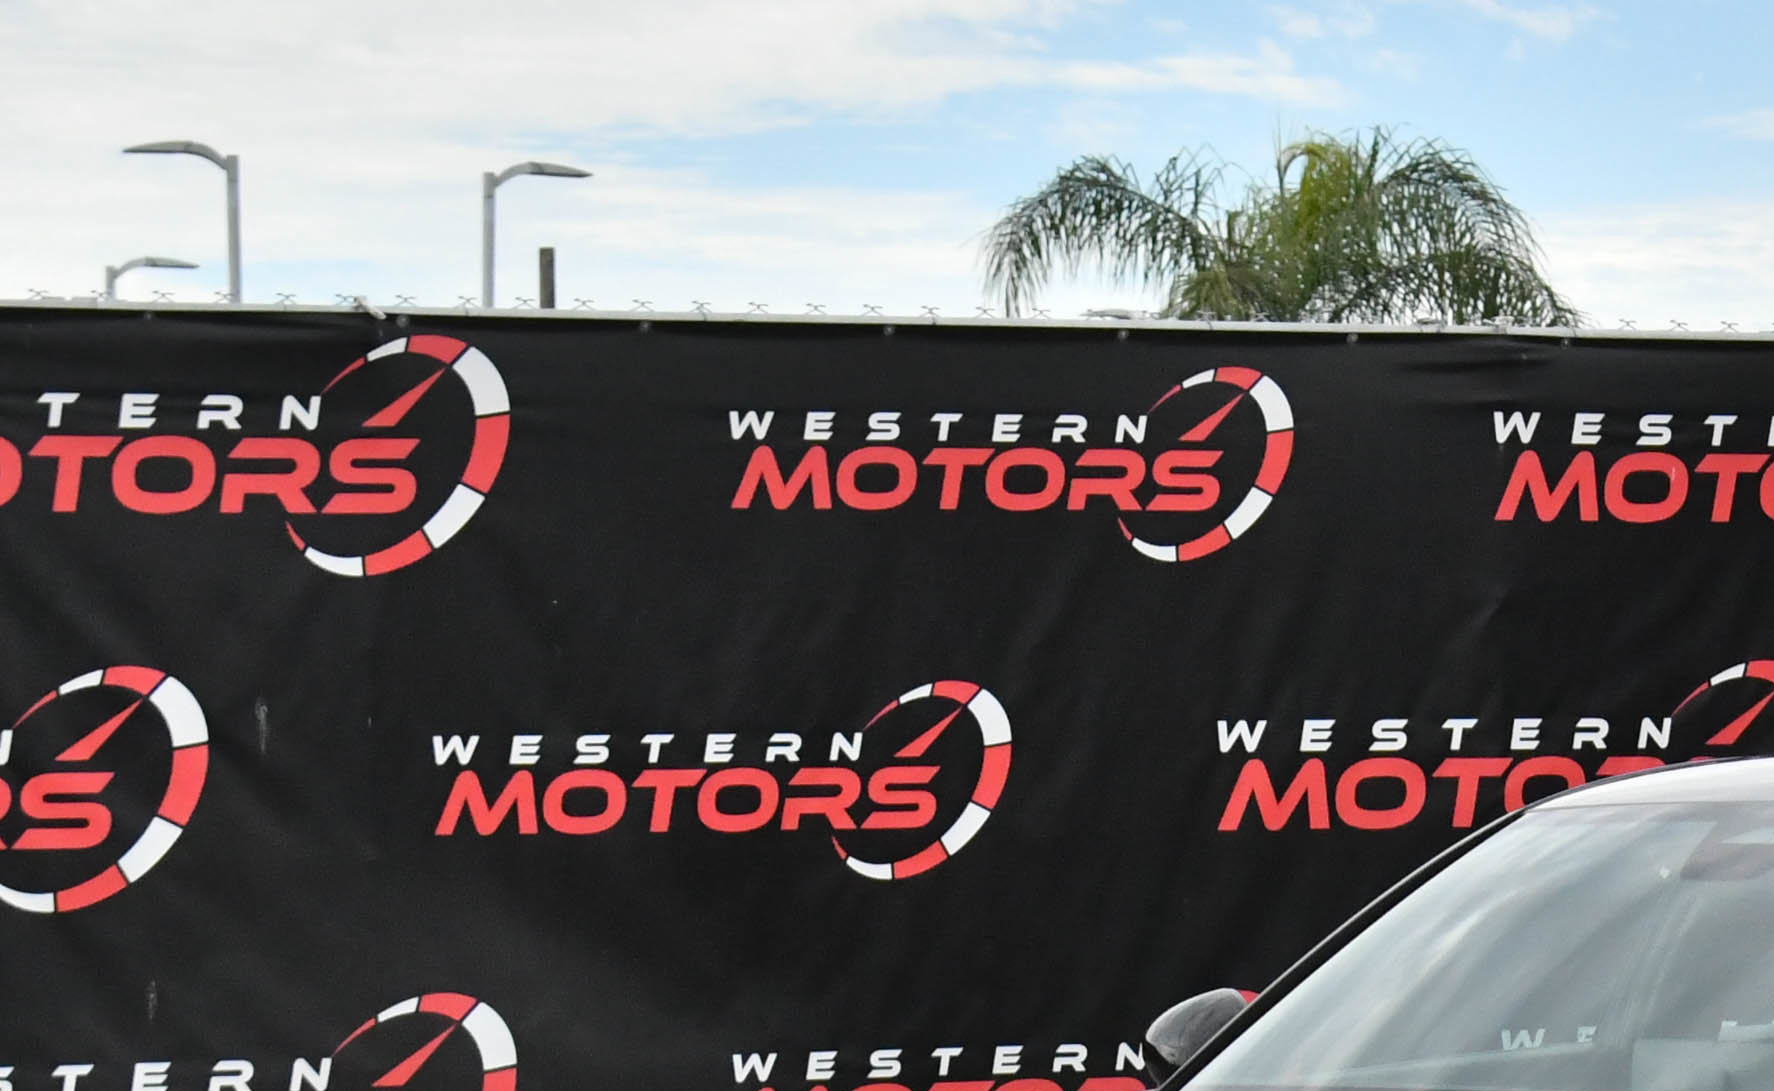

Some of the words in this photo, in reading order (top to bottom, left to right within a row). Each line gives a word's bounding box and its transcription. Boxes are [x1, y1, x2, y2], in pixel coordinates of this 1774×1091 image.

[37, 392, 322, 431] TERN
[729, 410, 1148, 444] WESTERN
[0, 434, 420, 515] TORS
[731, 444, 1223, 512] MOTORS
[432, 731, 863, 766] WESTERN
[1217, 717, 1672, 754] WESTERN
[435, 765, 940, 836] MOTORS
[1218, 755, 1724, 832] MOTO
[732, 1042, 1146, 1084] WESTERN
